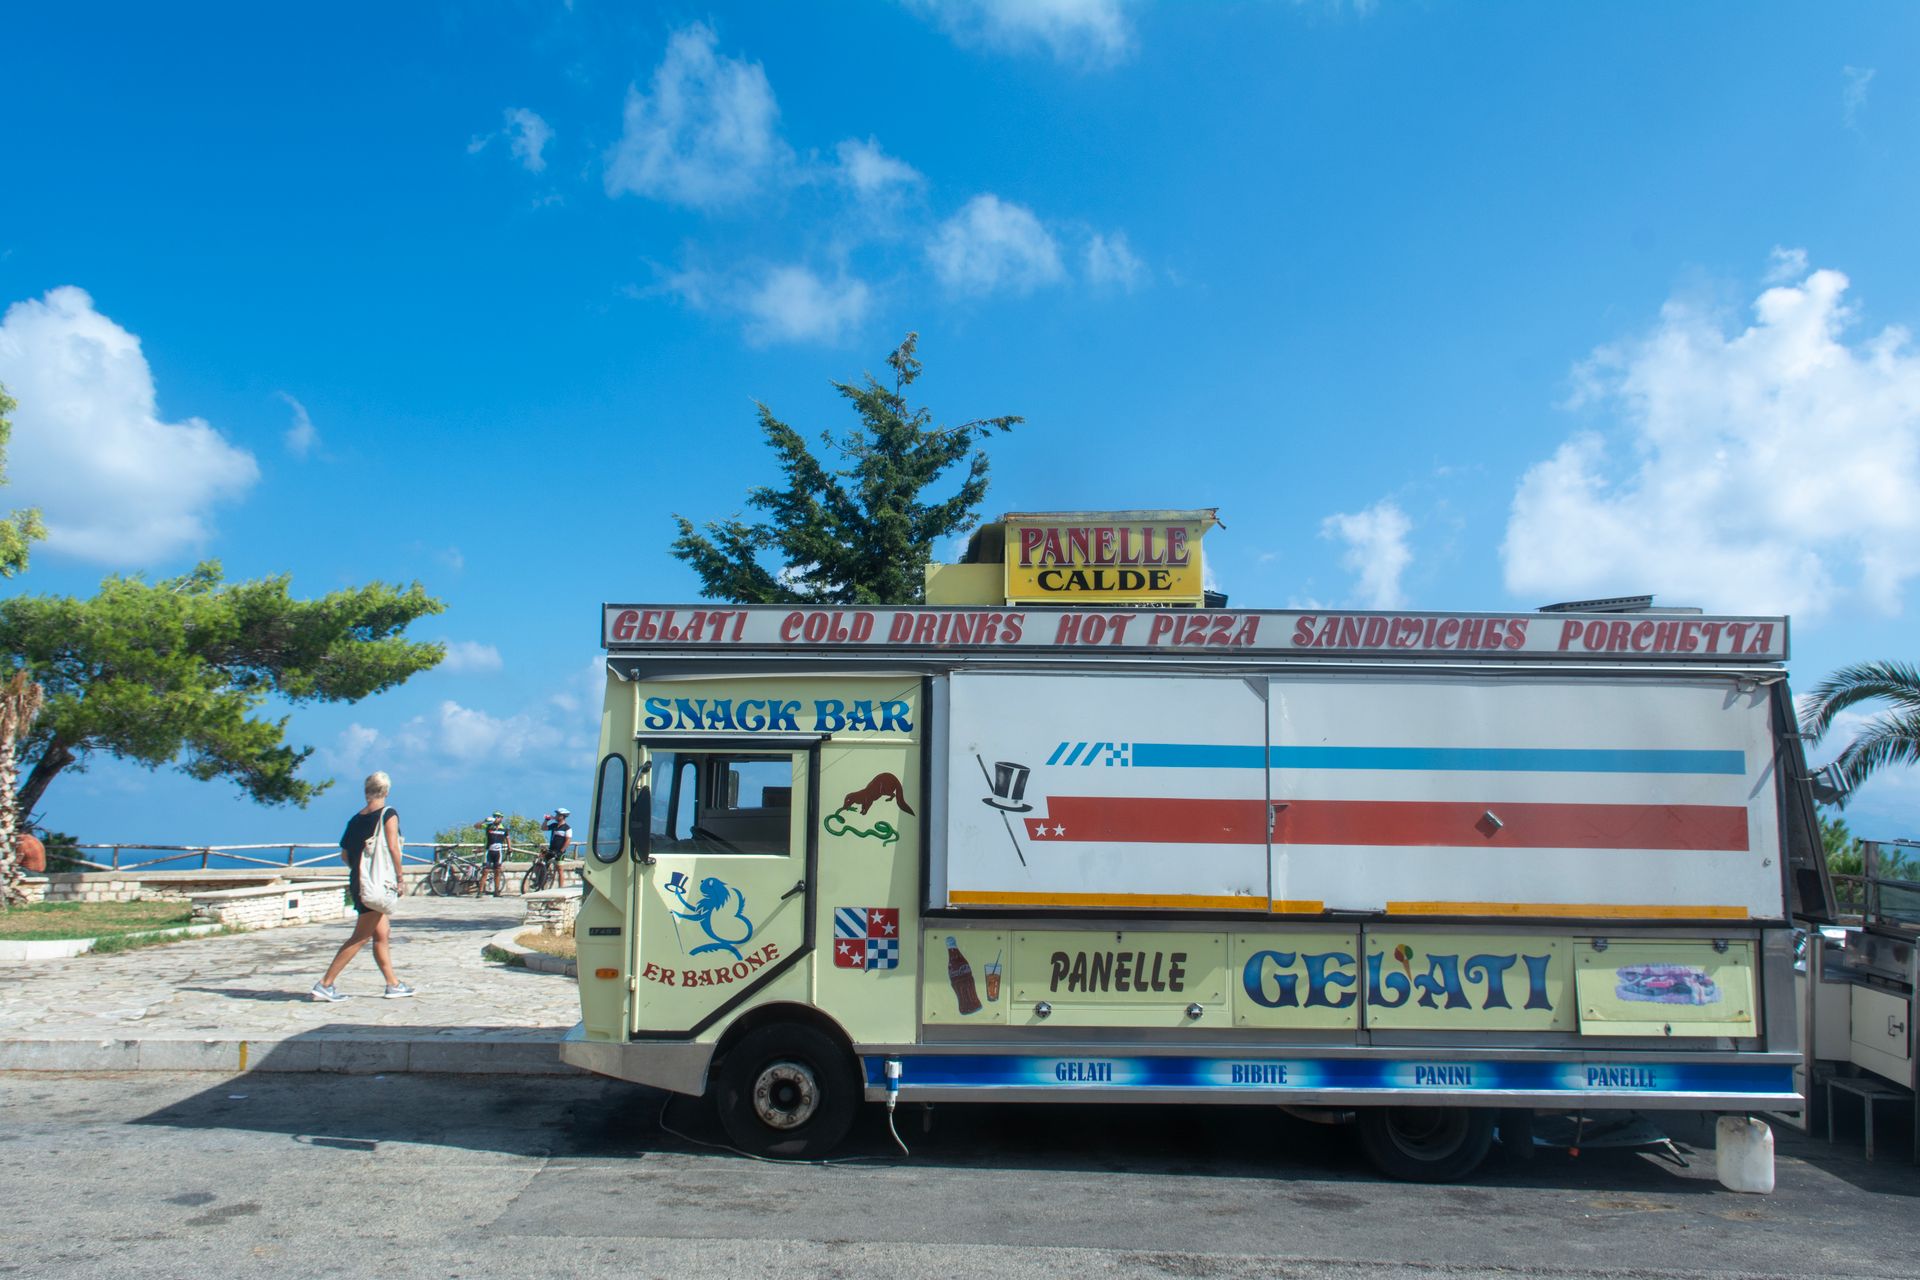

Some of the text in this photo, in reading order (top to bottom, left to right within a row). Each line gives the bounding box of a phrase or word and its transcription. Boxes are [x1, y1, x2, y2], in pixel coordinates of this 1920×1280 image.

[1019, 527, 1190, 567] PANELLE
[1037, 570, 1173, 591] CALDE
[612, 610, 1774, 654] GELATI COLD DRINKS HOT PIZZA SANDWICHES PORCHETTA
[644, 697, 914, 732] SNACK BAR
[642, 943, 780, 987] ER BARONE
[1050, 951, 1187, 992] PANELLE
[1243, 950, 1554, 1010] GELATI
[1055, 1062, 1112, 1081] GELATI
[1231, 1064, 1288, 1084] BIBITE
[1415, 1066, 1472, 1085] PANINI
[1587, 1067, 1657, 1087] PANELLE
